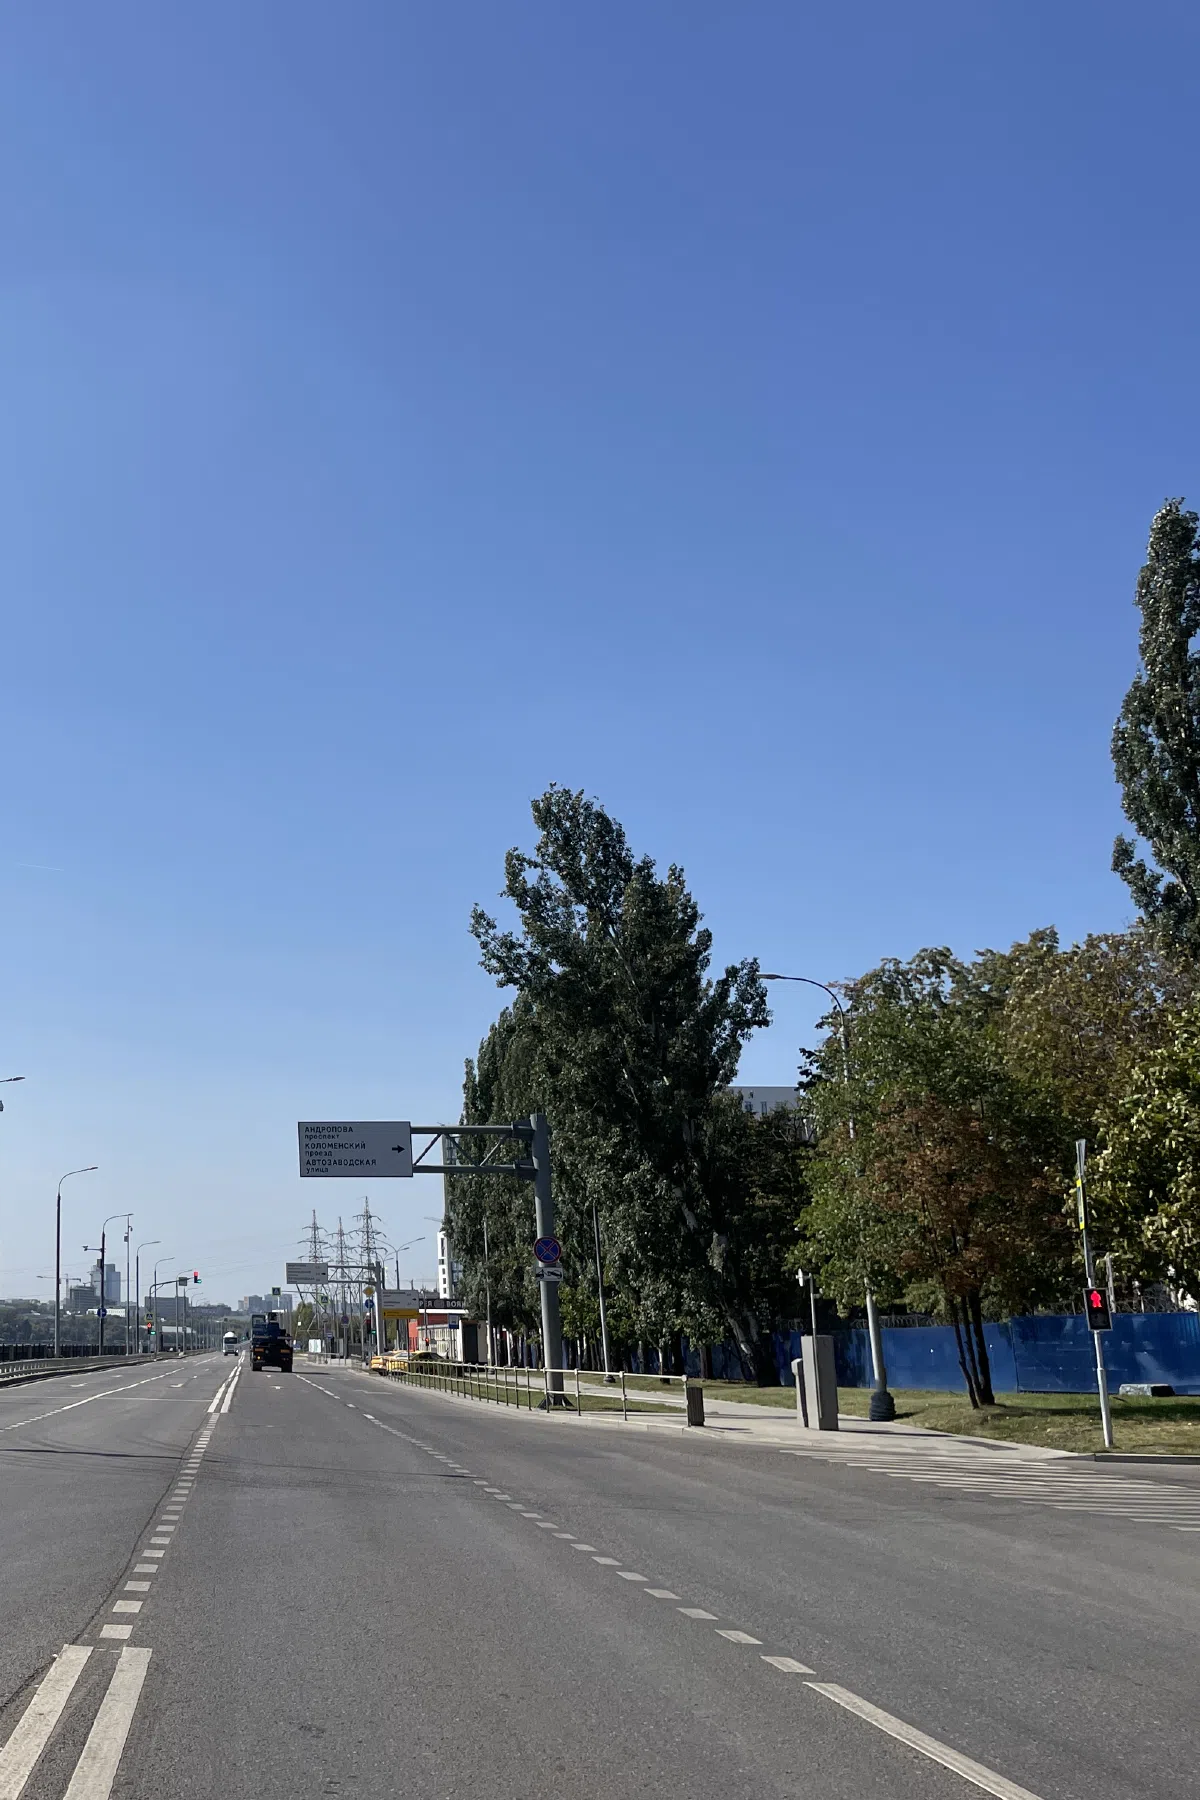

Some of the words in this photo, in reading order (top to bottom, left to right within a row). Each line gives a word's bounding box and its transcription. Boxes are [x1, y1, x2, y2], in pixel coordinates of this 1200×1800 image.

[304, 1126, 354, 1134] АНДРОПОВА
[304, 1141, 366, 1150] КОЛОМЕНСКИЙ
[306, 1158, 377, 1167] АВТОЗАВОДСКАЯ
